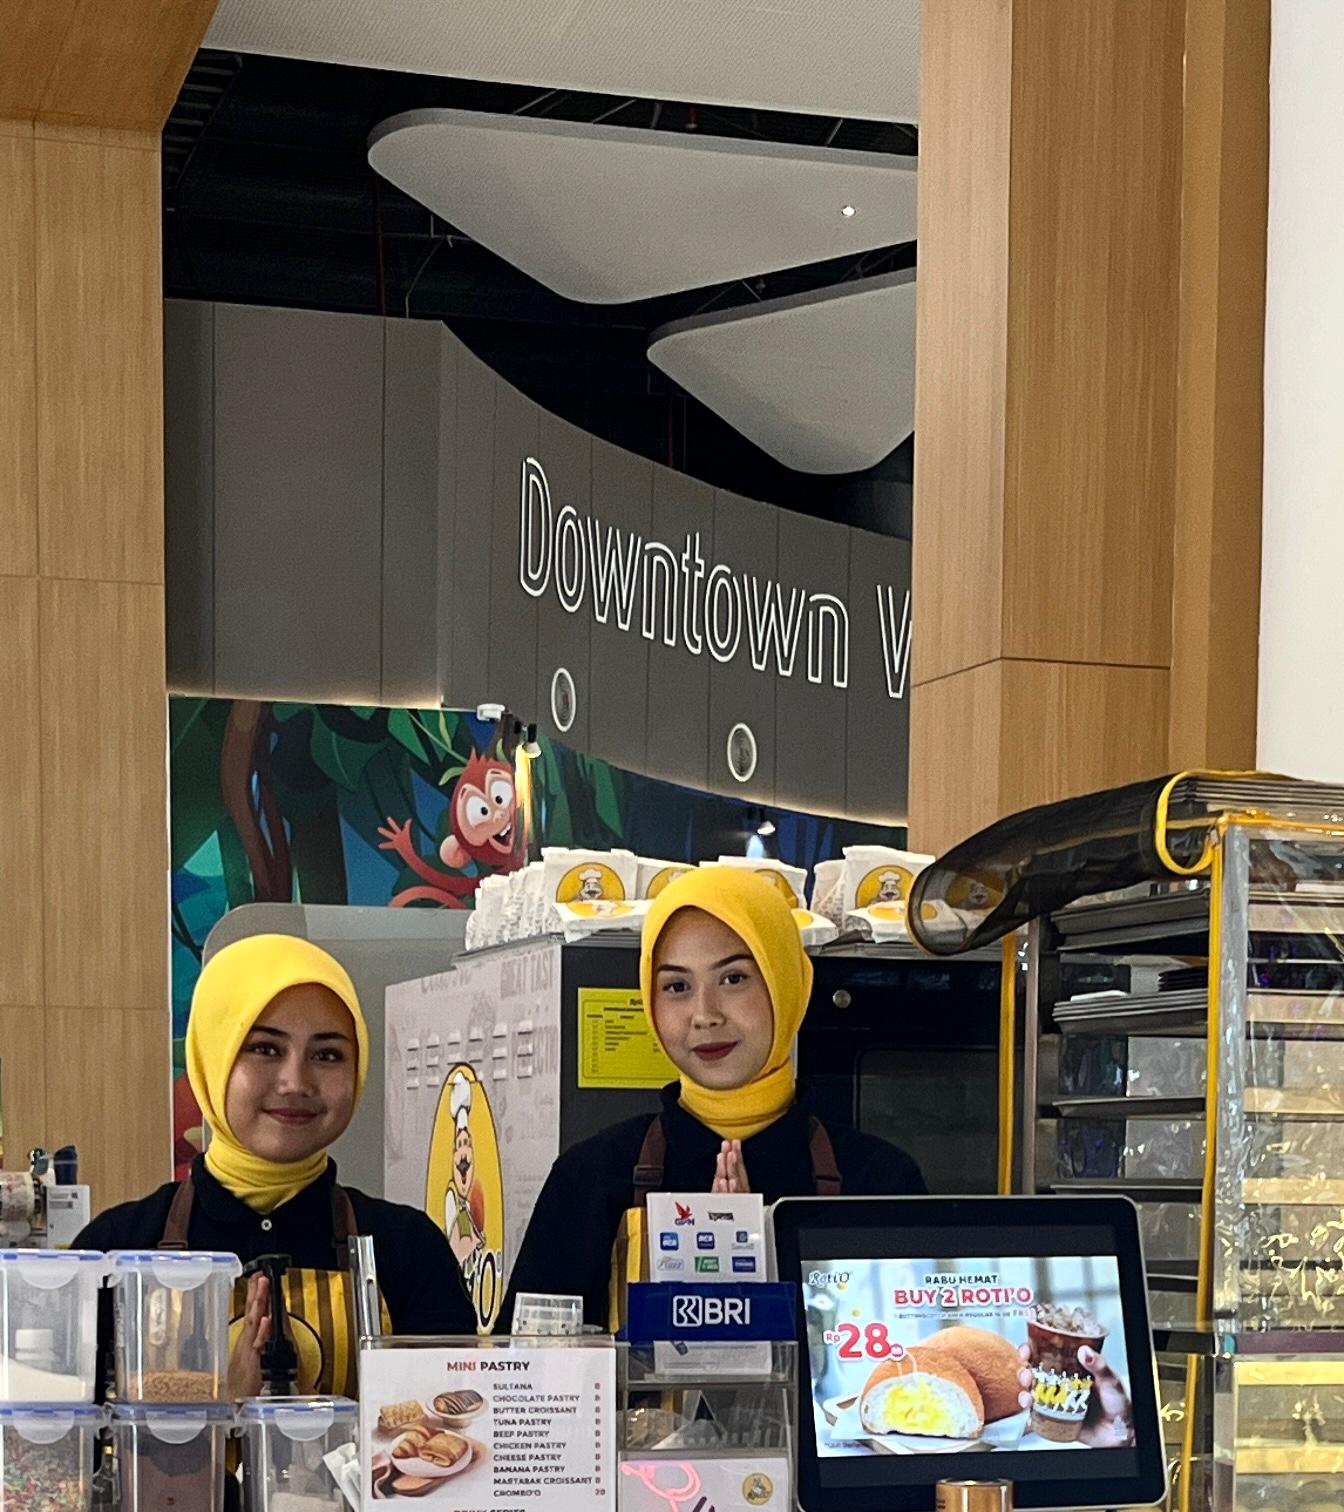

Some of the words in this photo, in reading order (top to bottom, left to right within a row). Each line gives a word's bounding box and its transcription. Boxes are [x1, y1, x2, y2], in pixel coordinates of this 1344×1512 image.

[520, 457, 849, 688] Downtown
[925, 1275, 957, 1284] RABU
[959, 1275, 998, 1284] HEMAT
[894, 1290, 937, 1304] BUY
[942, 1289, 955, 1304] 2
[962, 1288, 1032, 1303] ROTI'O
[704, 1298, 751, 1325] BRI
[838, 1323, 890, 1358] 28
[447, 1361, 476, 1372] MINI
[480, 1361, 530, 1372] PASTRY
[493, 1383, 533, 1391] SULTANA
[493, 1395, 545, 1403] CHOCOLATE
[547, 1395, 580, 1403] PASTRY
[493, 1442, 532, 1450] CHICKEN
[534, 1442, 567, 1450] PASTRY
